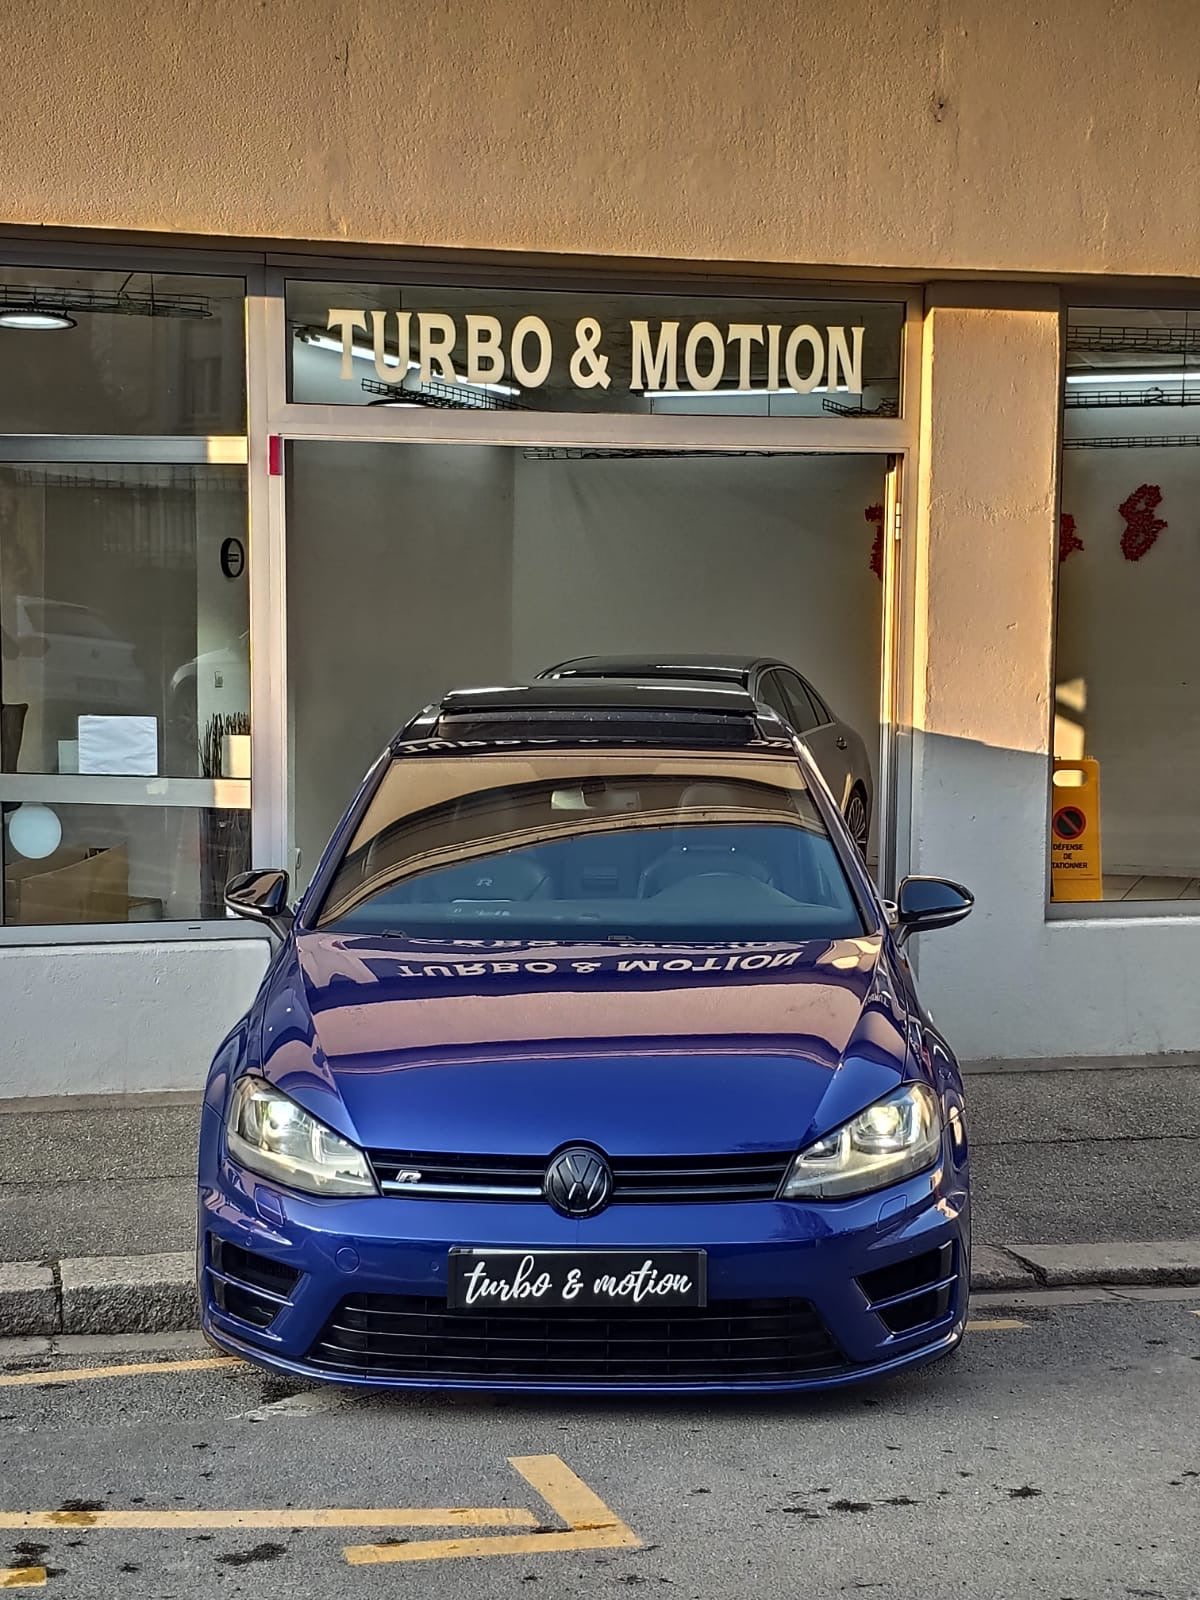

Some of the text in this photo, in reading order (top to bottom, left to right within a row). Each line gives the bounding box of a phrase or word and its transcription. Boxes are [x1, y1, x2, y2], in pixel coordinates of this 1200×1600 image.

[327, 309, 866, 394] TURBO & MOTION
[395, 1169, 422, 1184] R
[463, 1255, 692, 1305] turbo & motion
